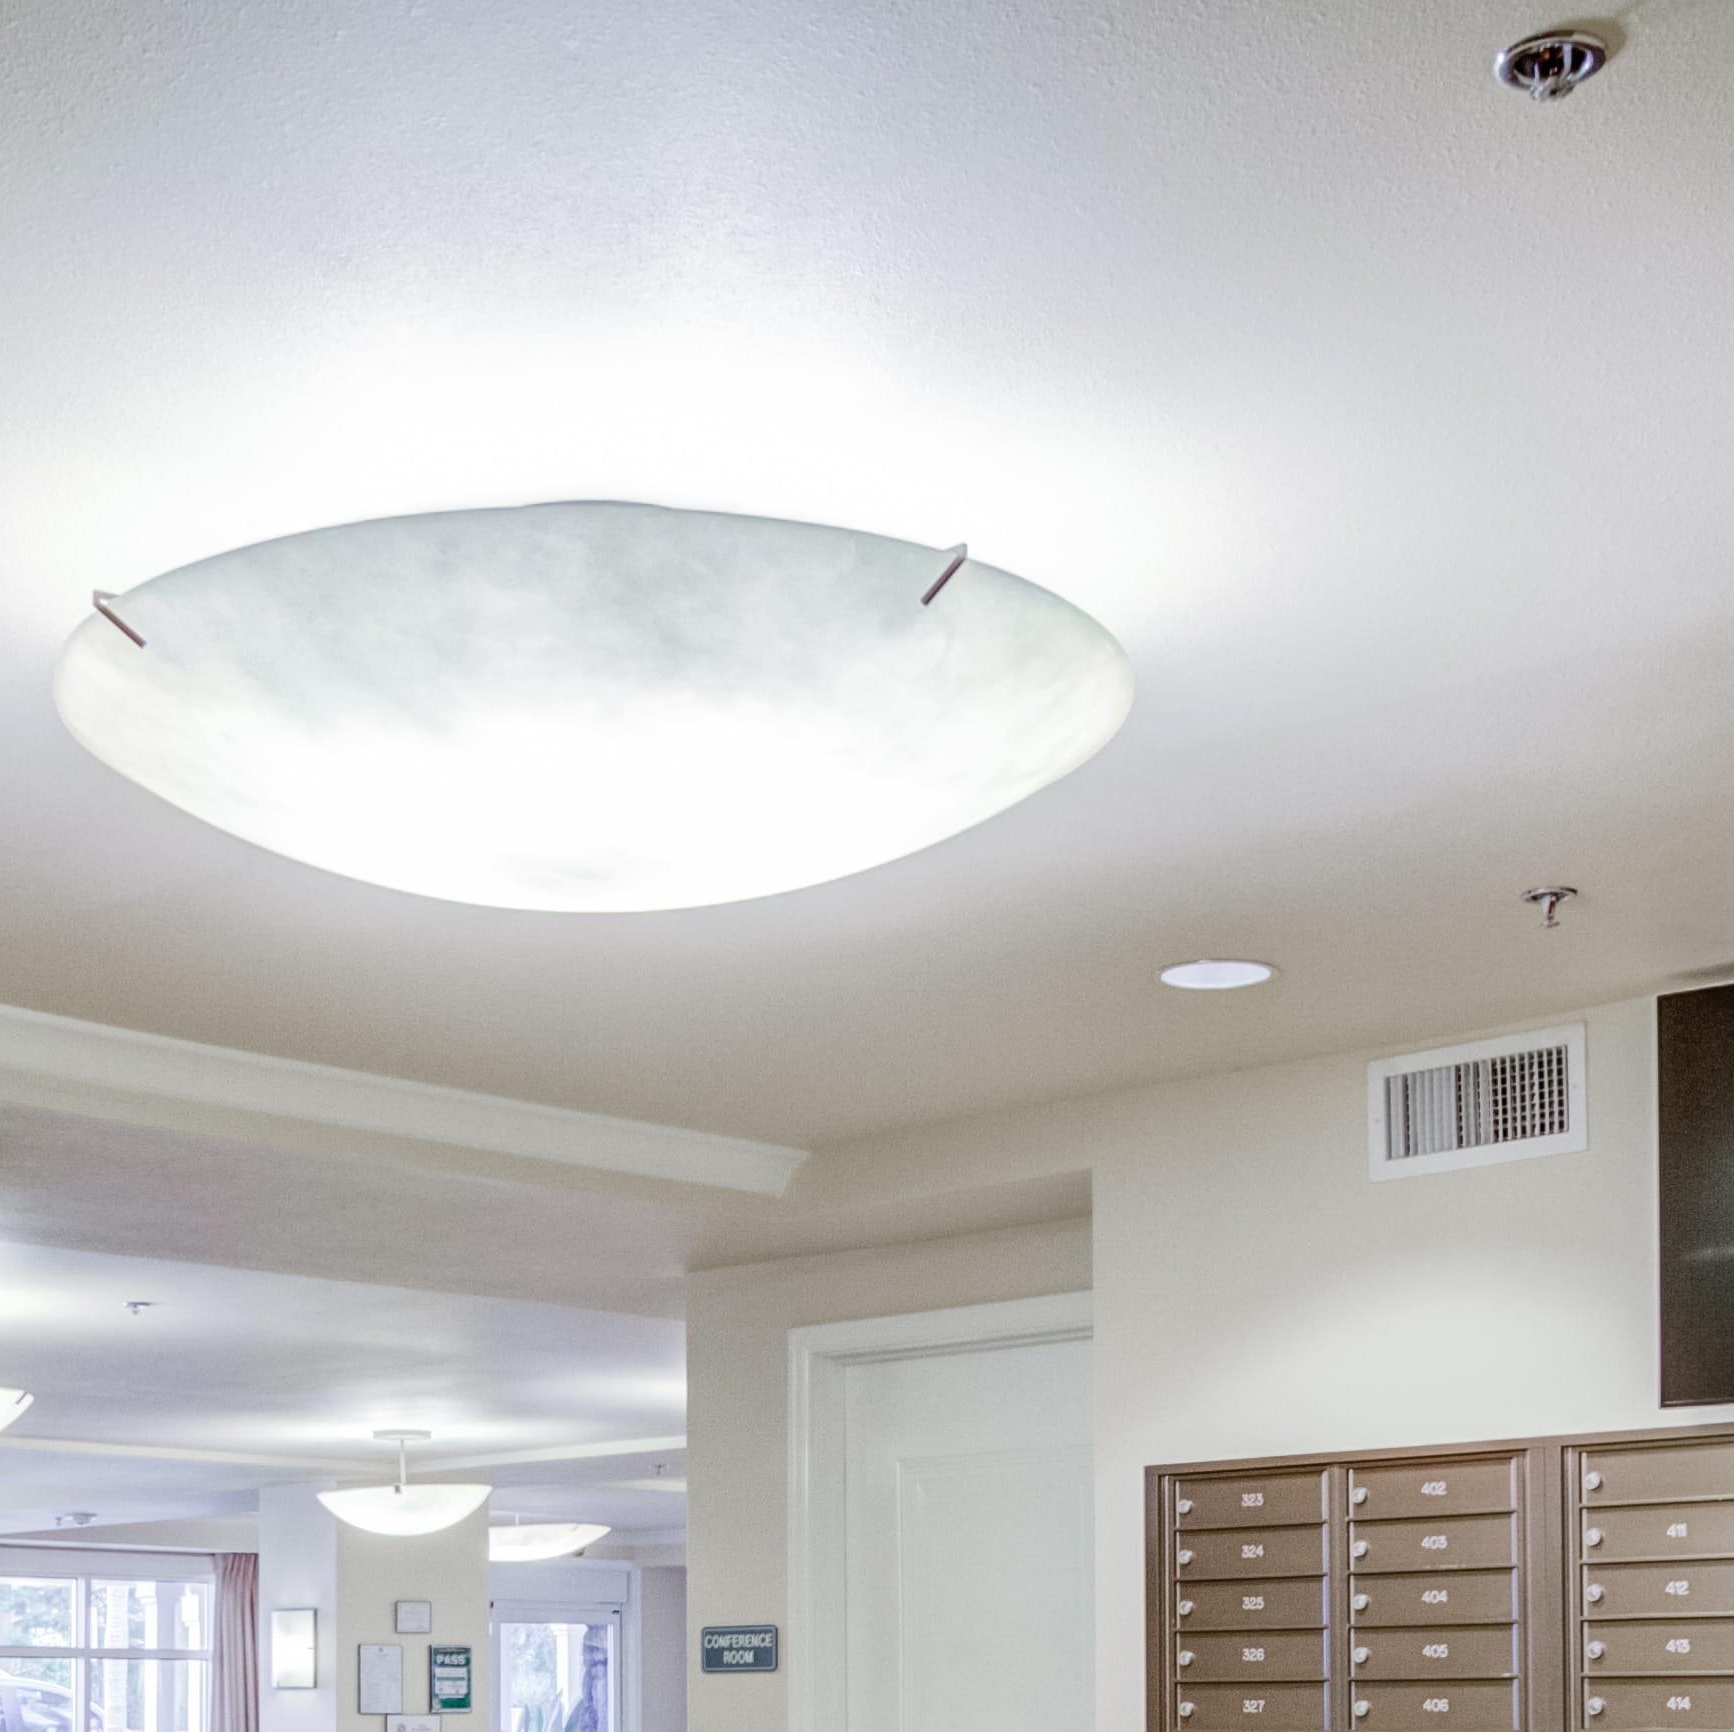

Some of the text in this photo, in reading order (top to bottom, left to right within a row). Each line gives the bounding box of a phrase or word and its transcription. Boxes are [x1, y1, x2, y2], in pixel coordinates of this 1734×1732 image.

[1420, 1480, 1447, 1496] 402
[1241, 1492, 1264, 1507] 323
[1420, 1535, 1448, 1550] 403
[1241, 1544, 1265, 1559] 324
[1664, 1580, 1690, 1596] 412
[1241, 1596, 1265, 1610] 325
[1421, 1589, 1448, 1604] 404
[704, 1633, 773, 1649] CONFERENCE
[723, 1650, 755, 1665] ROOM
[1242, 1647, 1265, 1662] 326
[1422, 1643, 1449, 1658] 405
[436, 1654, 467, 1665] PASS
[1242, 1699, 1266, 1714] 327
[1422, 1698, 1450, 1713] 406
[1666, 1696, 1692, 1711] 414
